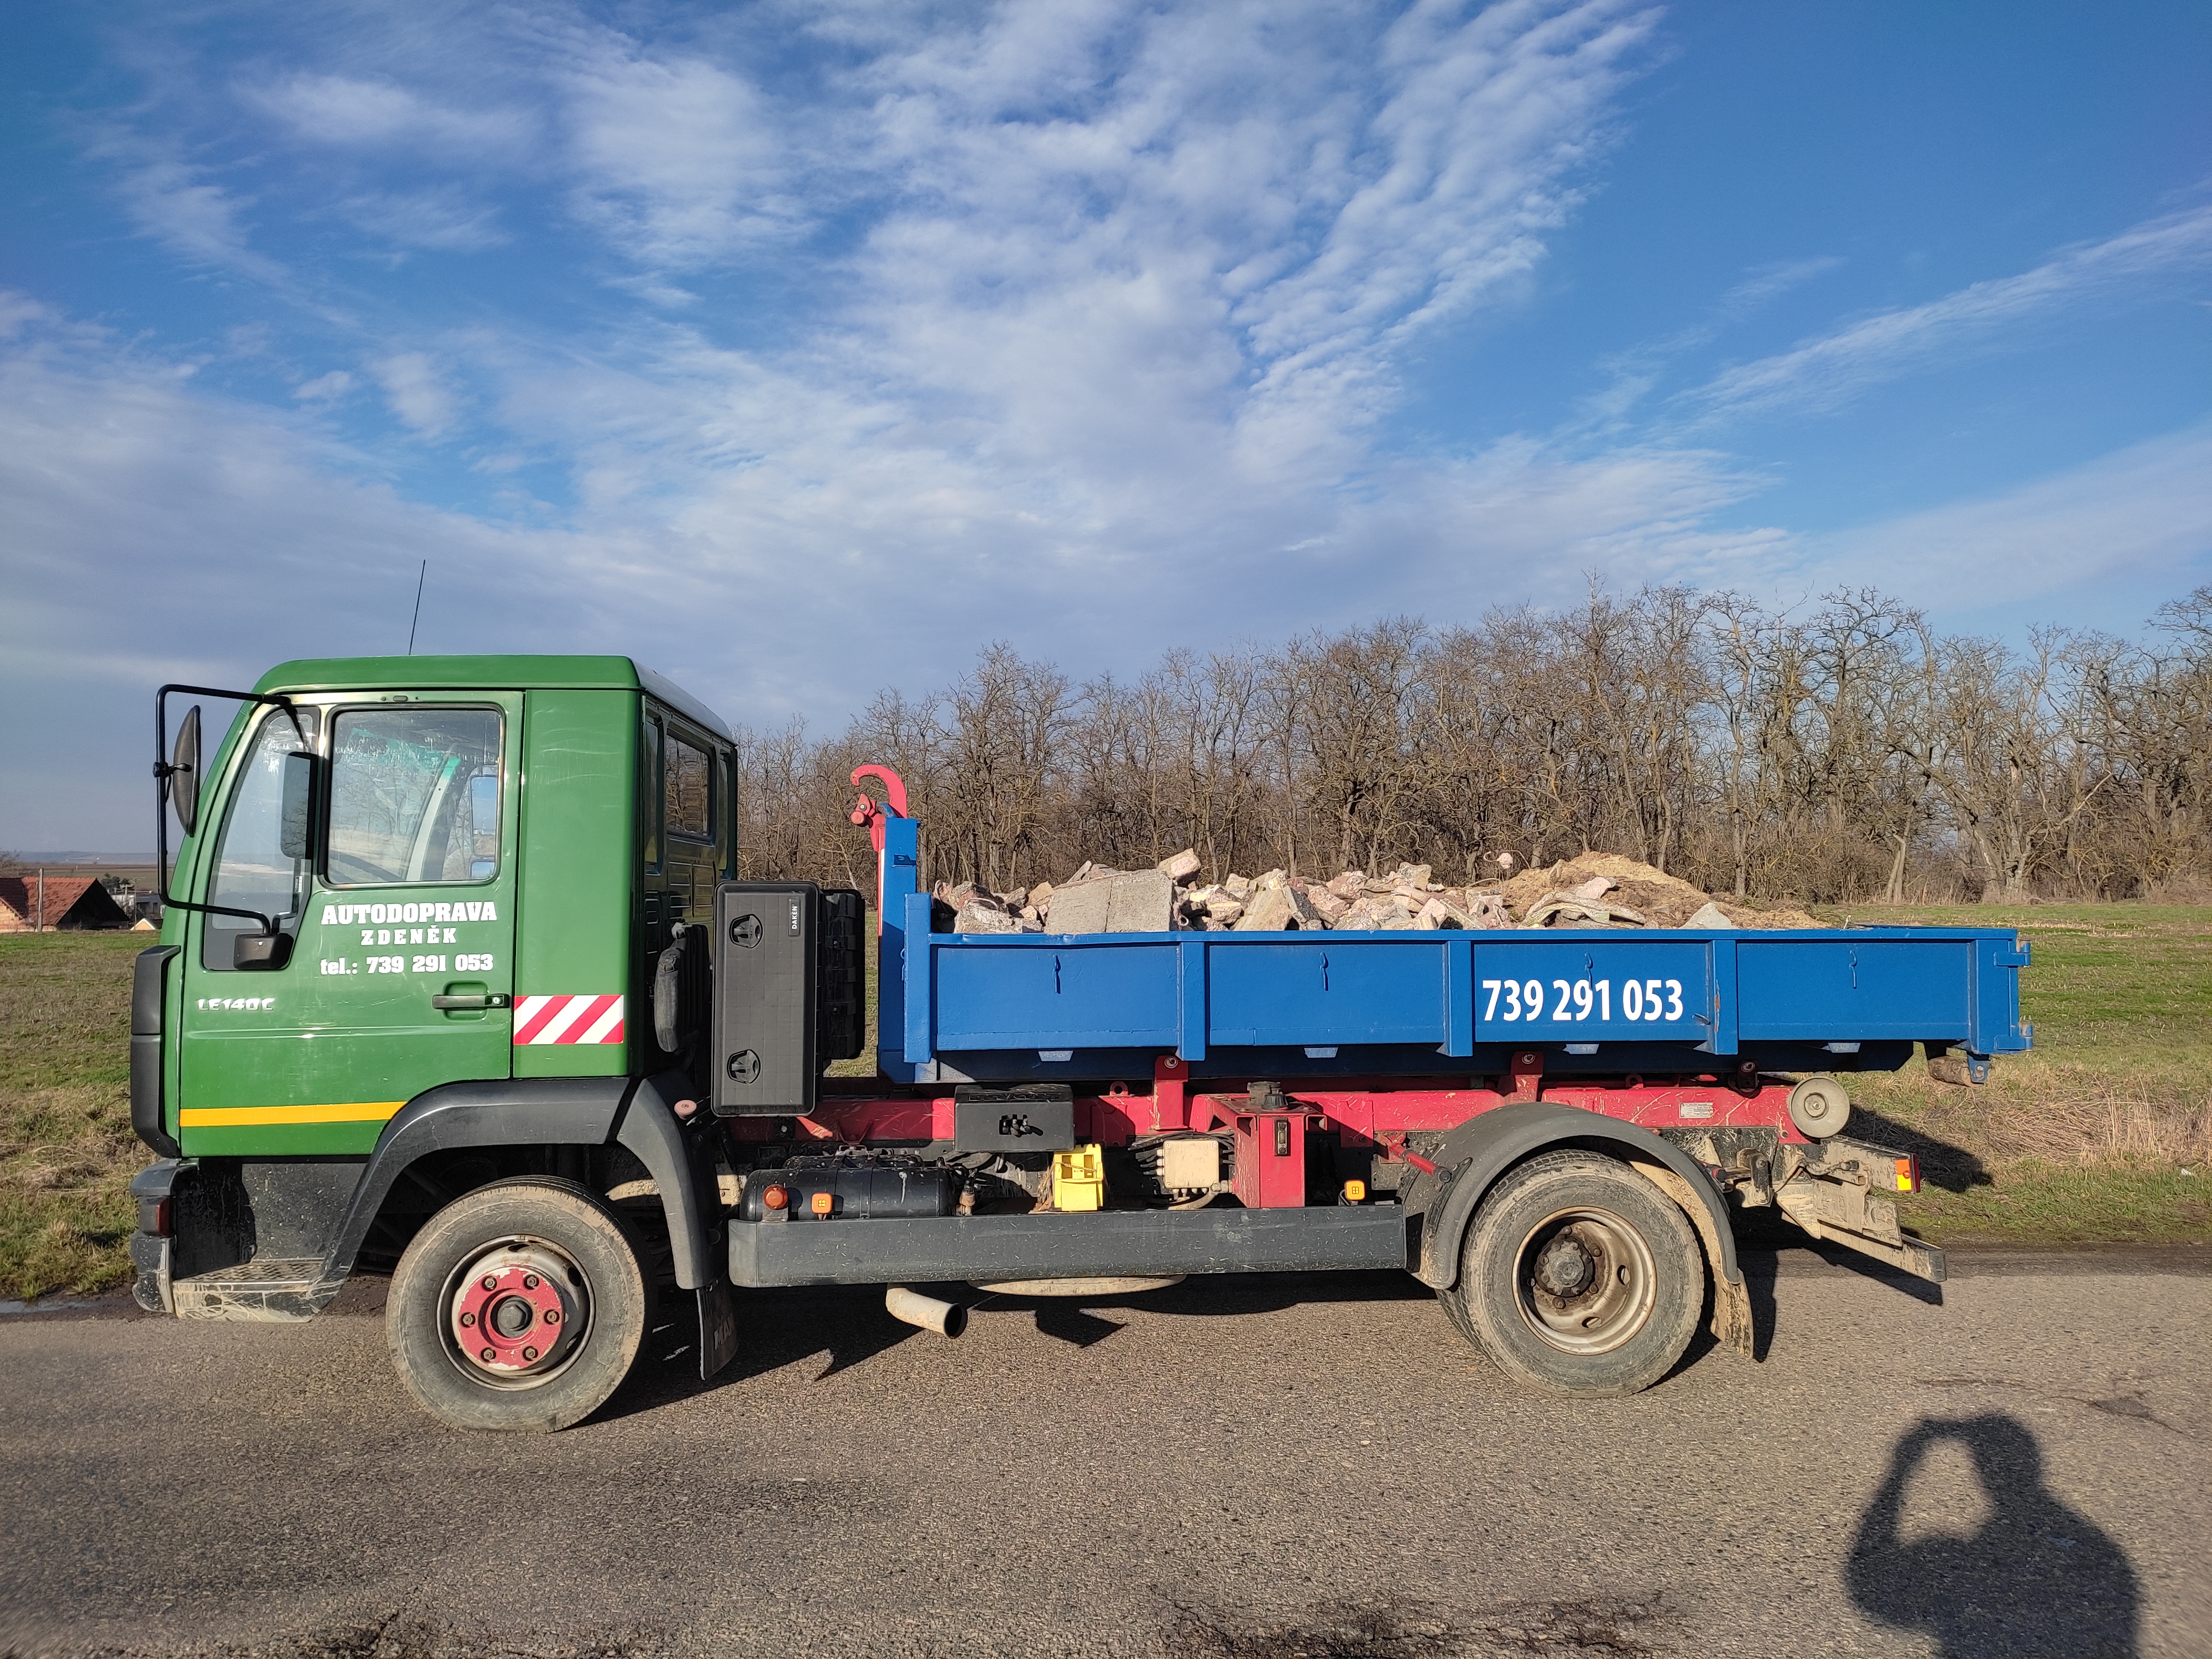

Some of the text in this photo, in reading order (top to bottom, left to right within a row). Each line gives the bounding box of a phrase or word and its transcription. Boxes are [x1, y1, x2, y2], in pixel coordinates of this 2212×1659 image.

[321, 901, 498, 925] AUTODOPRAVA
[361, 925, 457, 946] ZDENĚK
[320, 953, 494, 975] tel.: 739 291 053
[1483, 979, 1683, 1021] 739 291 053
